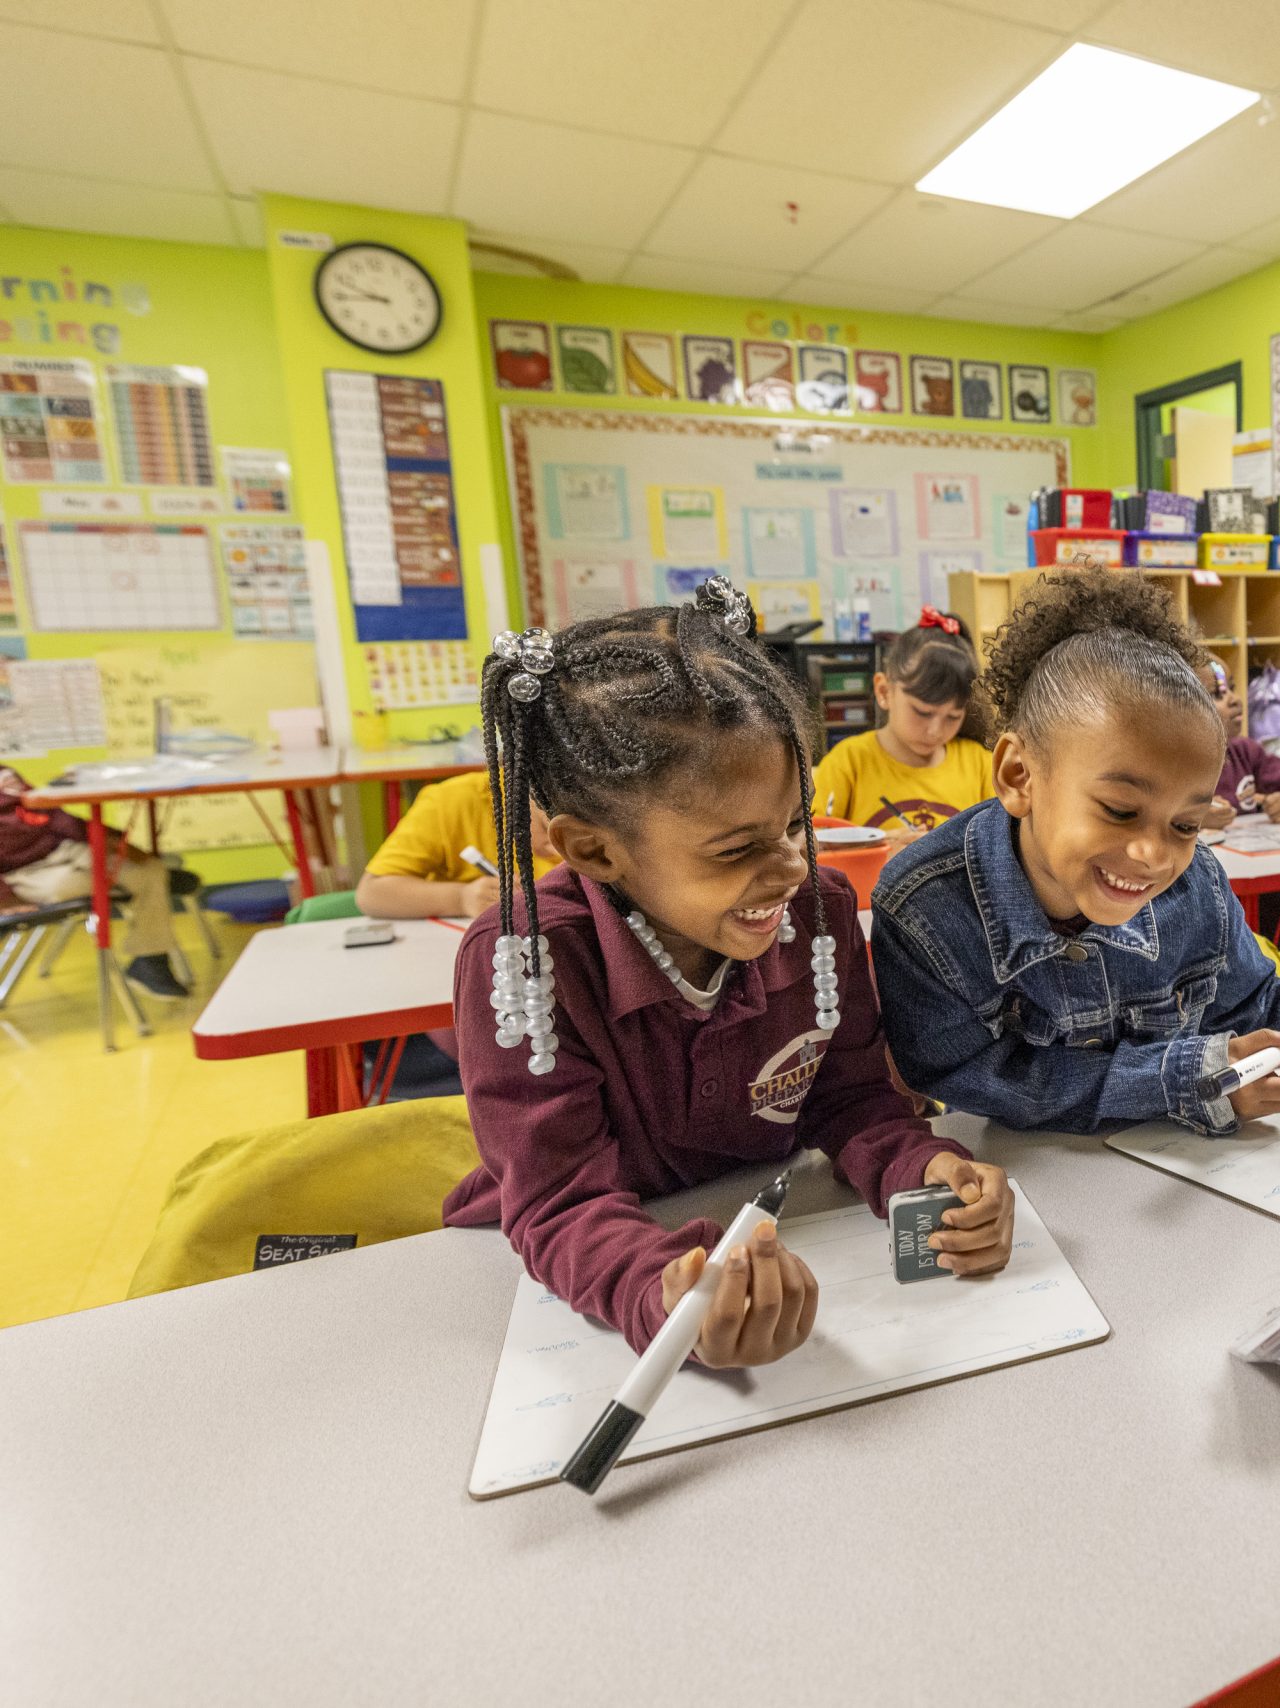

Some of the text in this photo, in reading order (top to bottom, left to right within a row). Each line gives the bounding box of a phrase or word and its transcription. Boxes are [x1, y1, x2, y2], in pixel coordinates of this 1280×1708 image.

[917, 1213, 932, 1231] DAY
[898, 1230, 915, 1258] TODAY
[918, 1257, 935, 1268] IS
